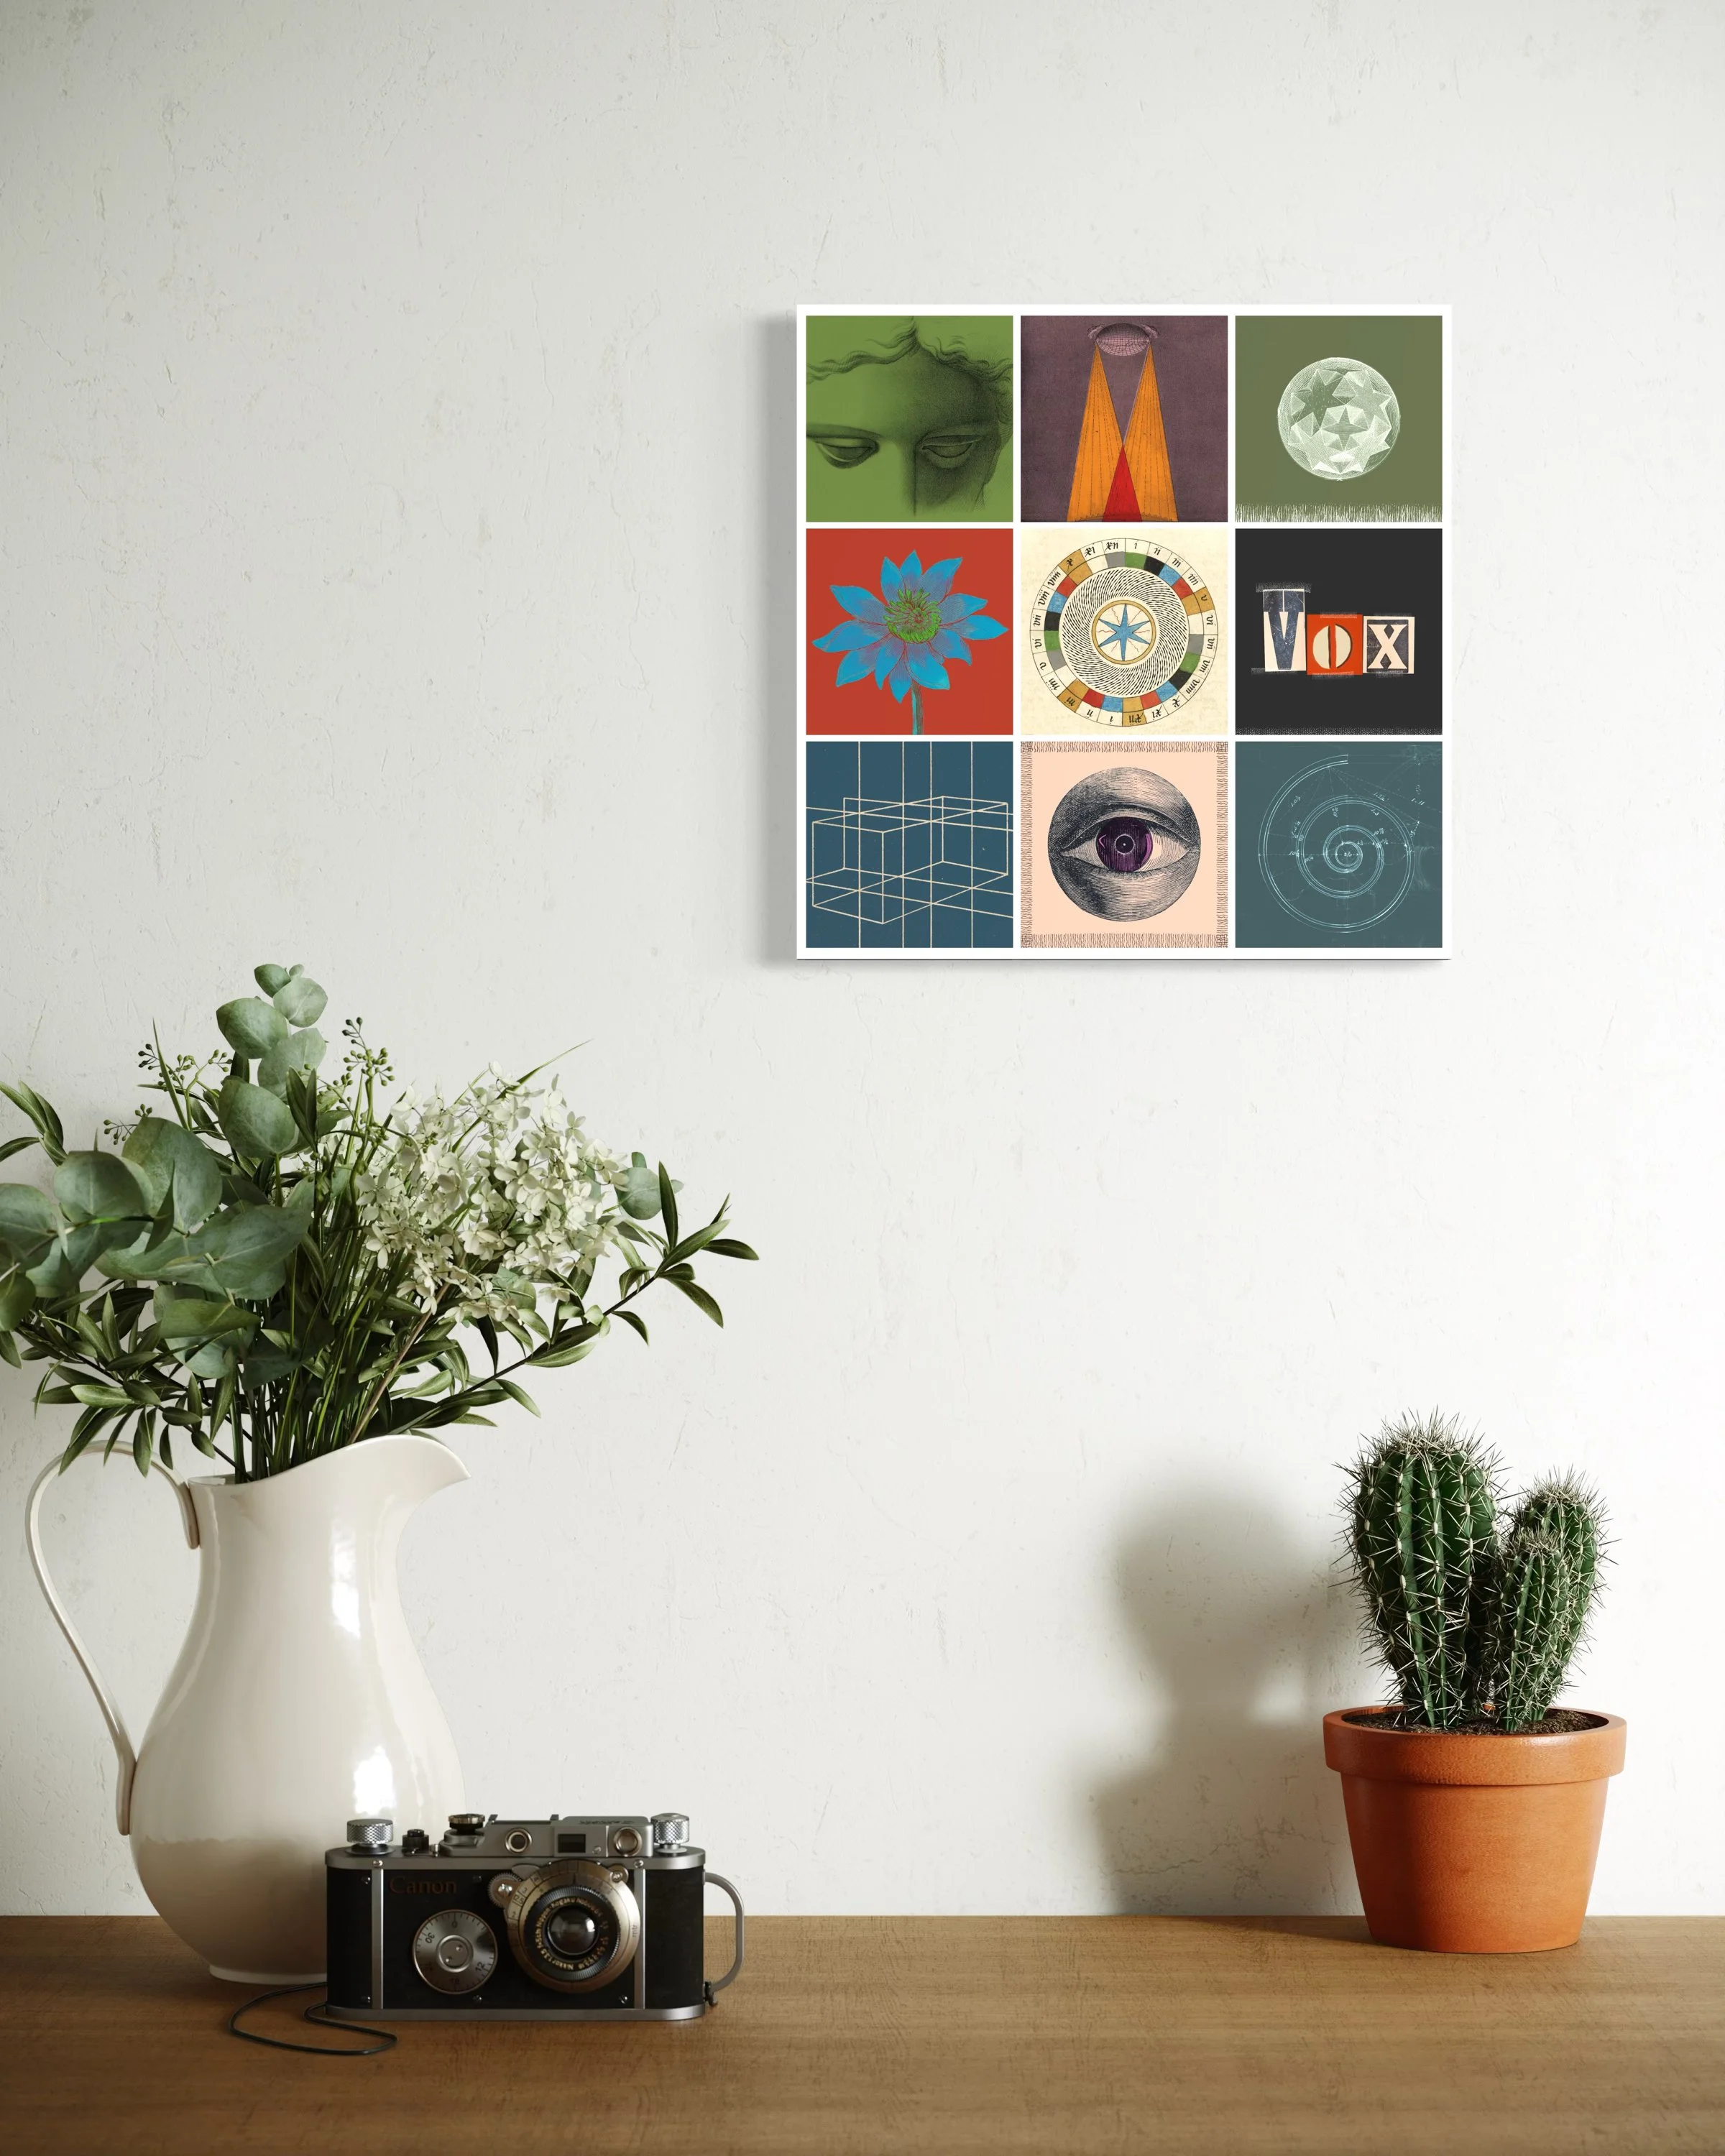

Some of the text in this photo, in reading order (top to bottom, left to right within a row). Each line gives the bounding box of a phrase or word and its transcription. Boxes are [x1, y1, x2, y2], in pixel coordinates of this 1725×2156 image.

[388, 1876, 457, 1894] Canon
[426, 1932, 436, 1944] 30
[474, 1962, 484, 1972] 12
